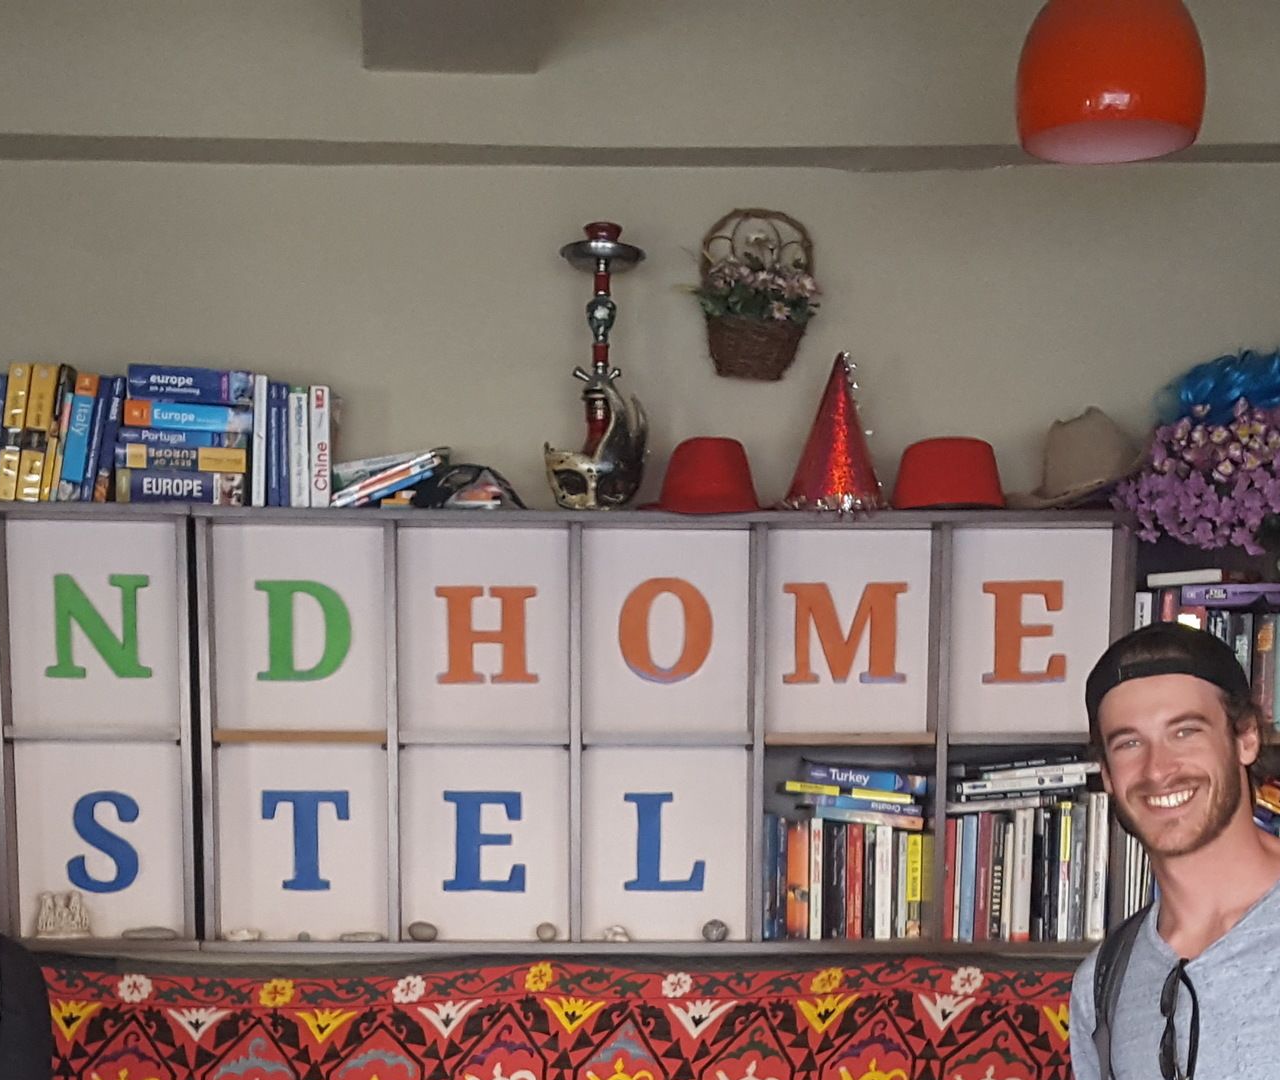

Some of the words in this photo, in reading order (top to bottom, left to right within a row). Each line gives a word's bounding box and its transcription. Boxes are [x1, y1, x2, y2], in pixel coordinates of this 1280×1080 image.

[149, 373, 194, 388] europe
[71, 402, 92, 436] Italy
[153, 409, 196, 424] Europe
[141, 429, 186, 444] Portugal
[314, 441, 328, 491] Chine
[142, 476, 203, 497] EUROPE
[828, 768, 870, 785] Turkey
[871, 801, 901, 812] Croatia
